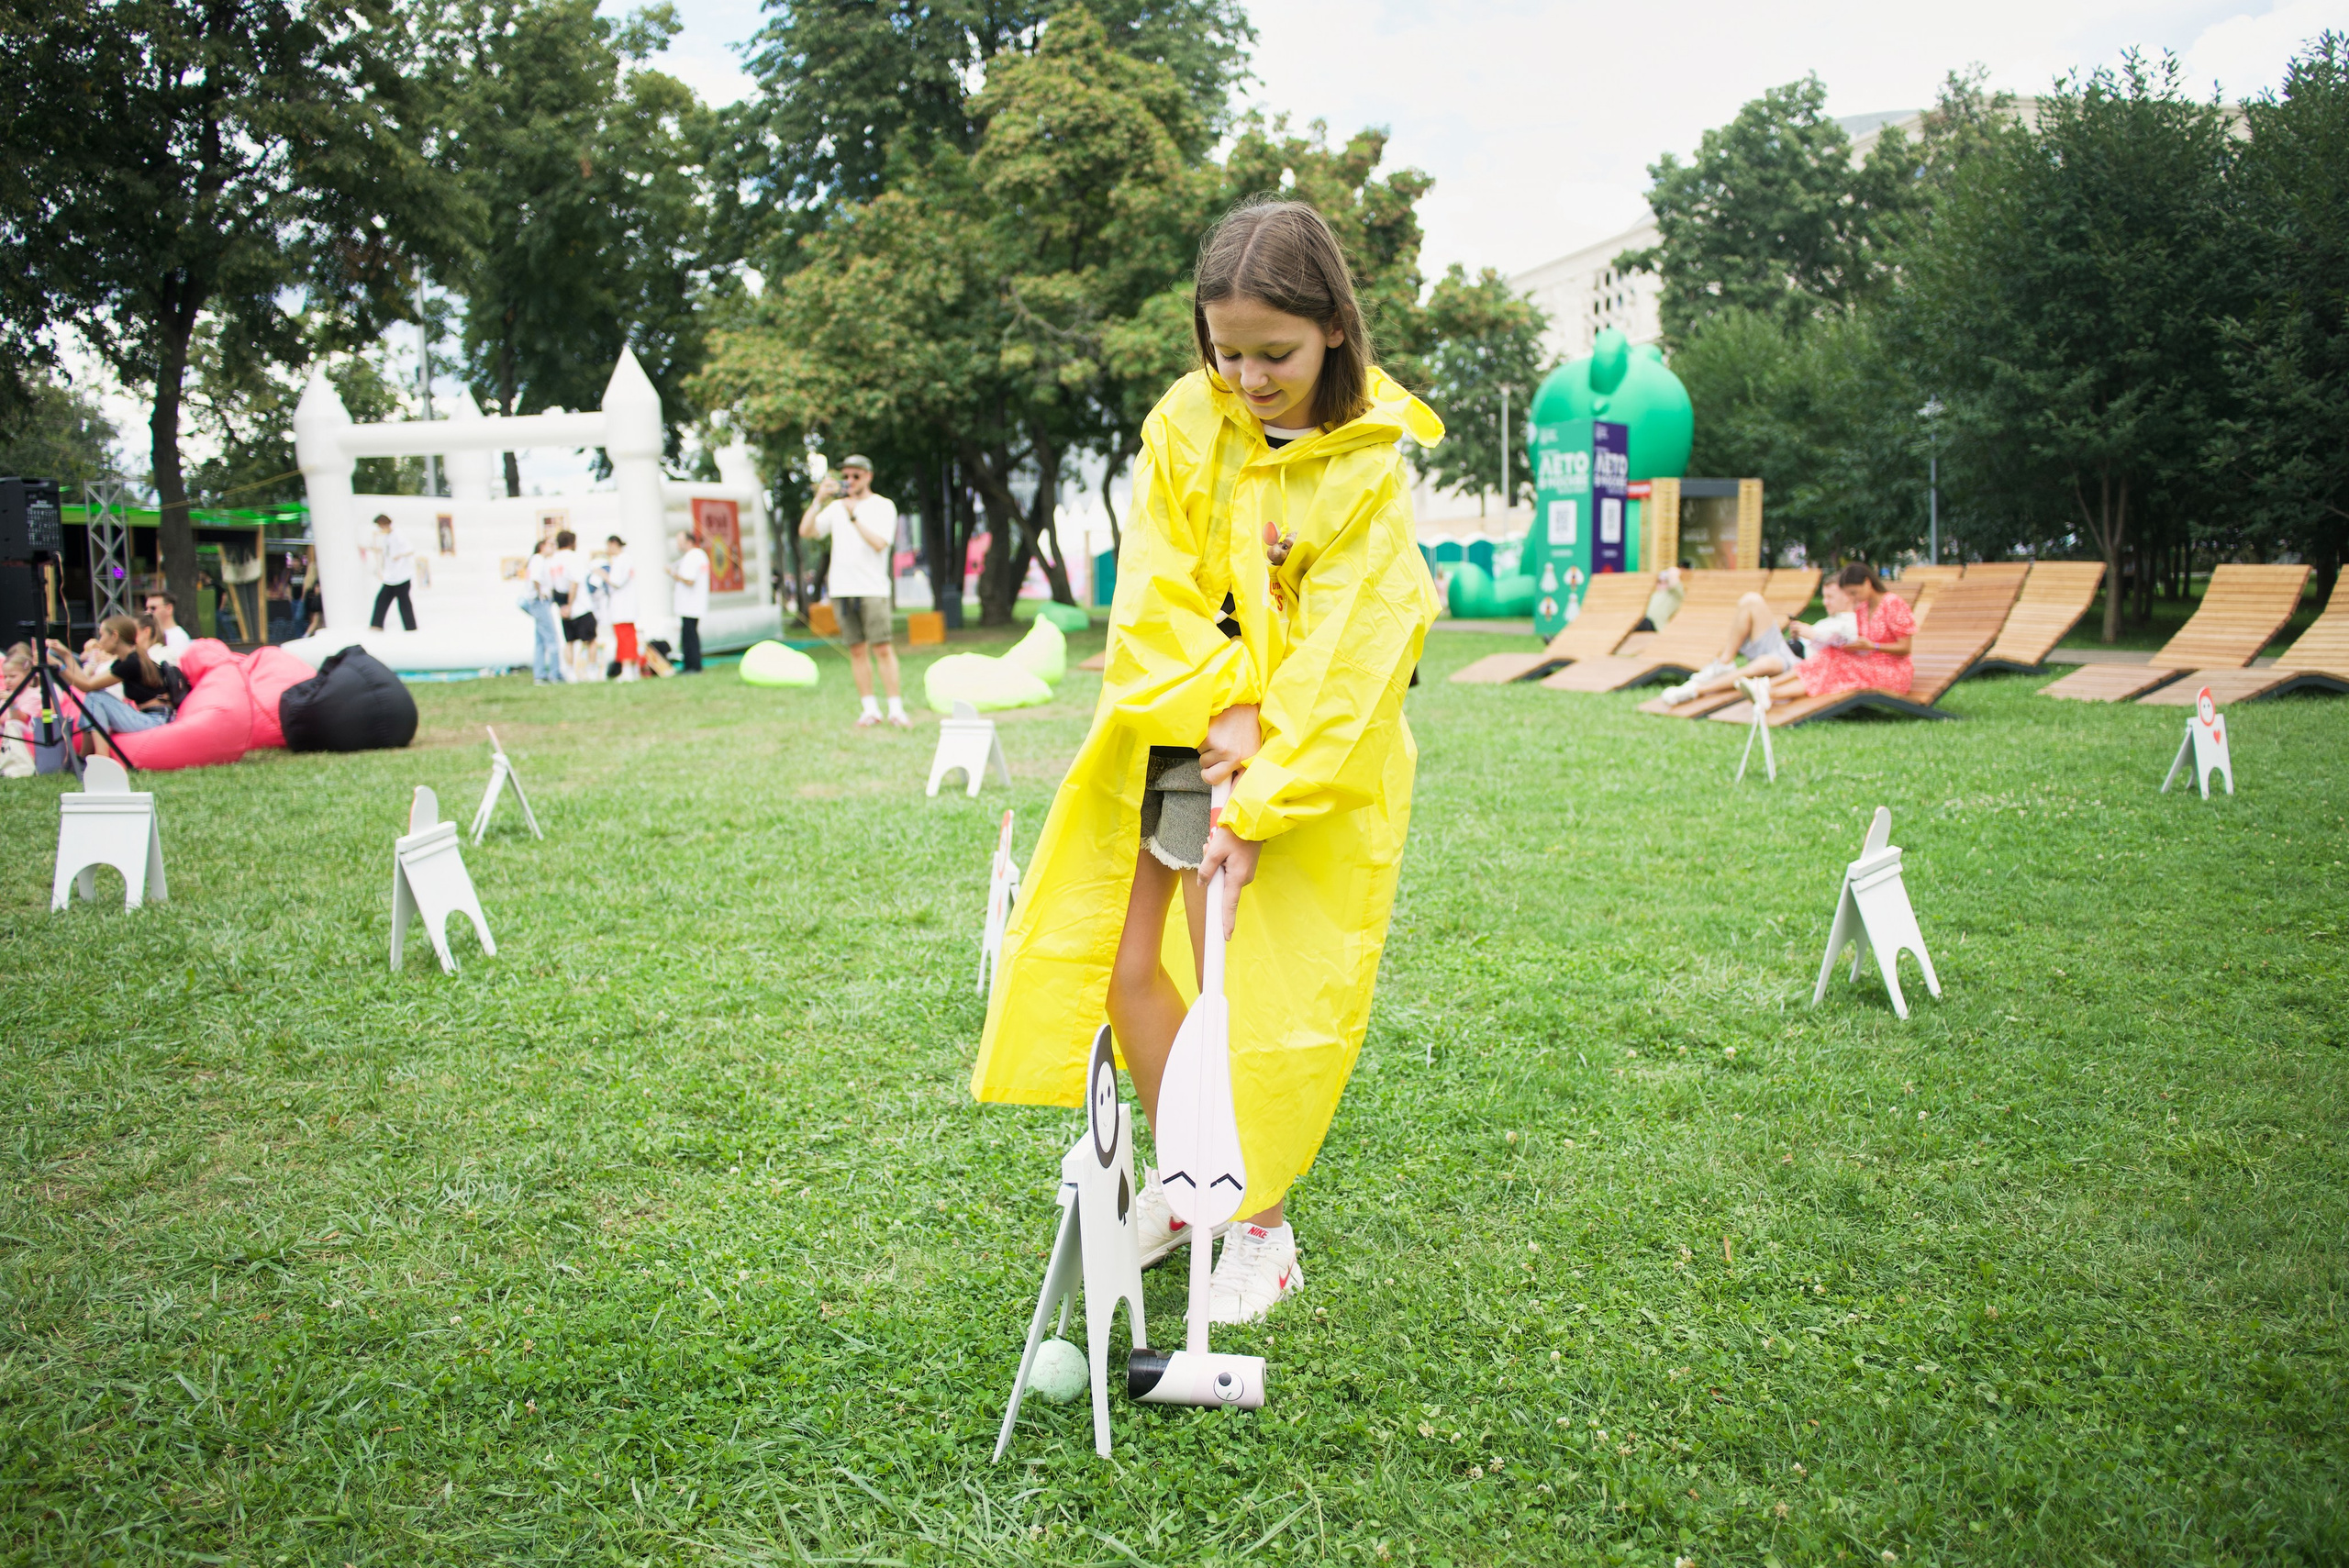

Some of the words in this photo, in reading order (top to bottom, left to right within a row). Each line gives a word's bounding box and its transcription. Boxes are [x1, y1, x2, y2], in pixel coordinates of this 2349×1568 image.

[1539, 450, 1589, 477] ЛЕТО
[1595, 451, 1629, 476] ЛЕТО
[1247, 1226, 1269, 1239] NIKE
